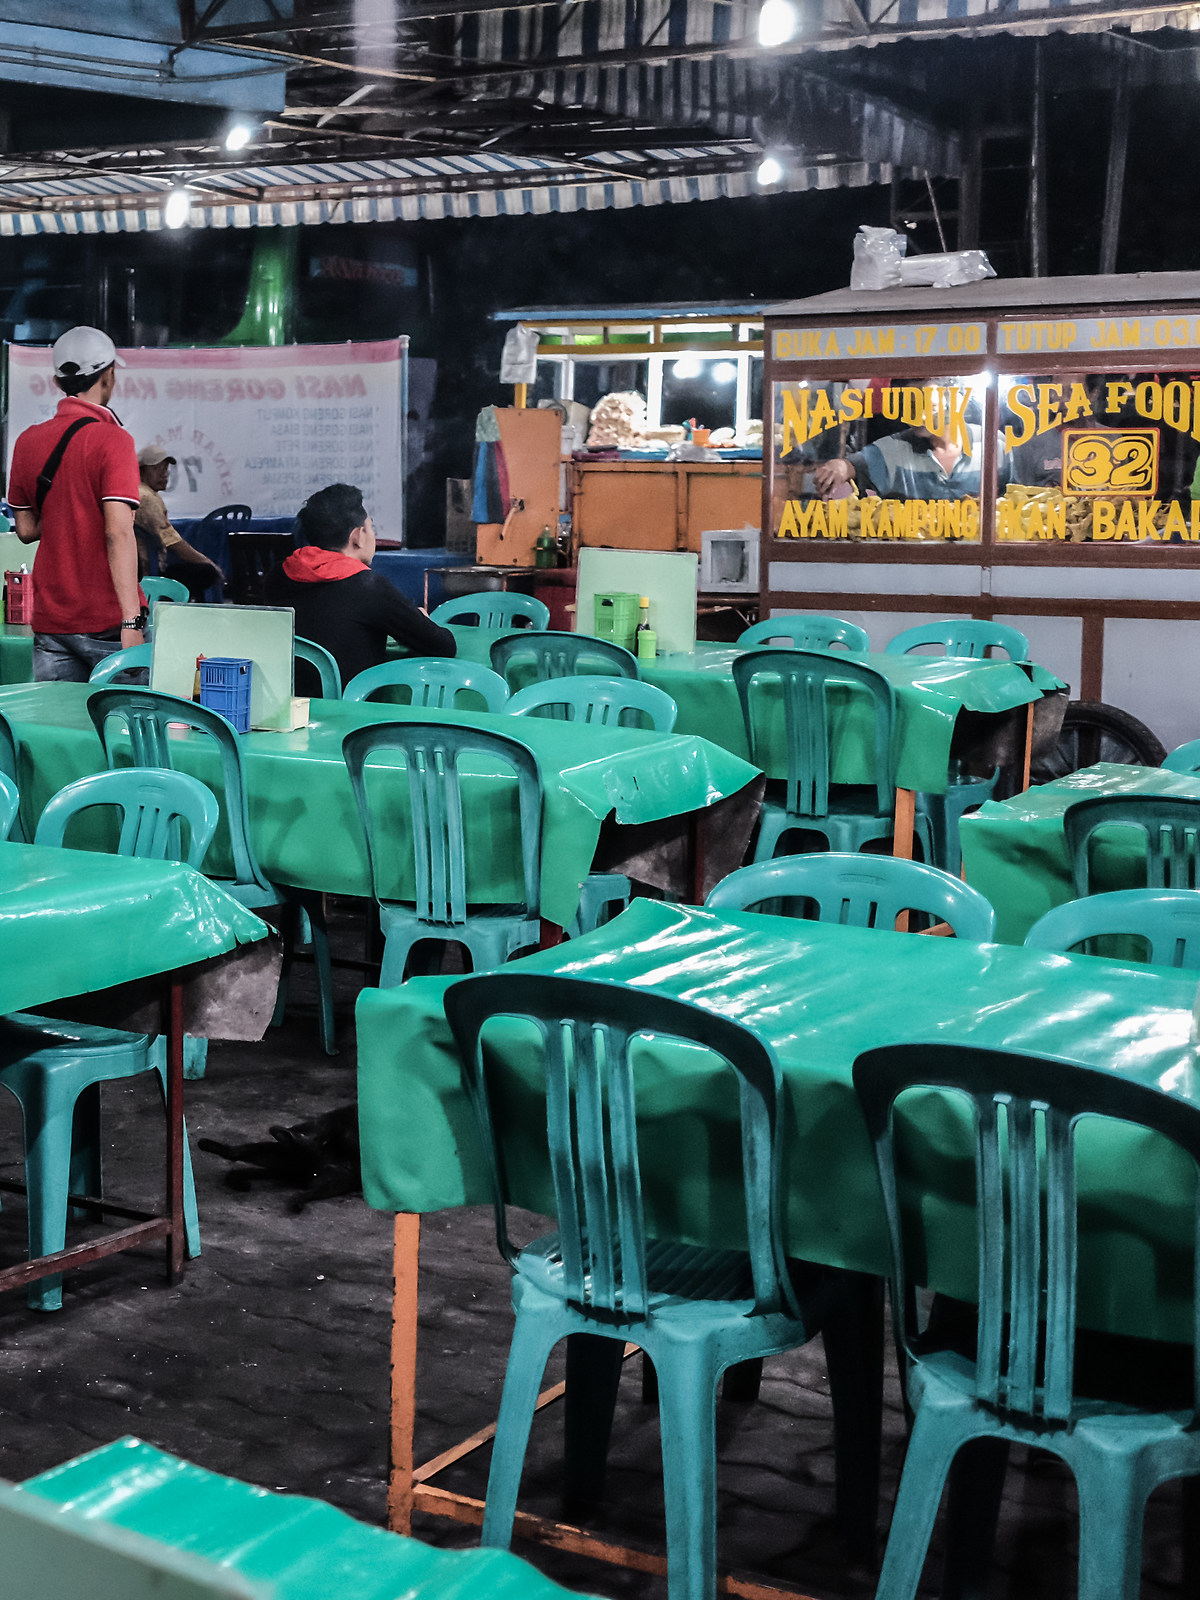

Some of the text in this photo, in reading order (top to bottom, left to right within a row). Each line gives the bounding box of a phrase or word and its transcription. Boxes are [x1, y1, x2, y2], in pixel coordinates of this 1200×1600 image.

[777, 329, 839, 358] BUKA
[1001, 322, 1077, 350] TUTUP
[779, 386, 973, 459] NASI UDUK
[1004, 383, 1093, 453] SEA
[1068, 436, 1153, 488] 32
[778, 499, 978, 539] AYAM KAMPUNG
[999, 499, 1066, 541] IKAN
